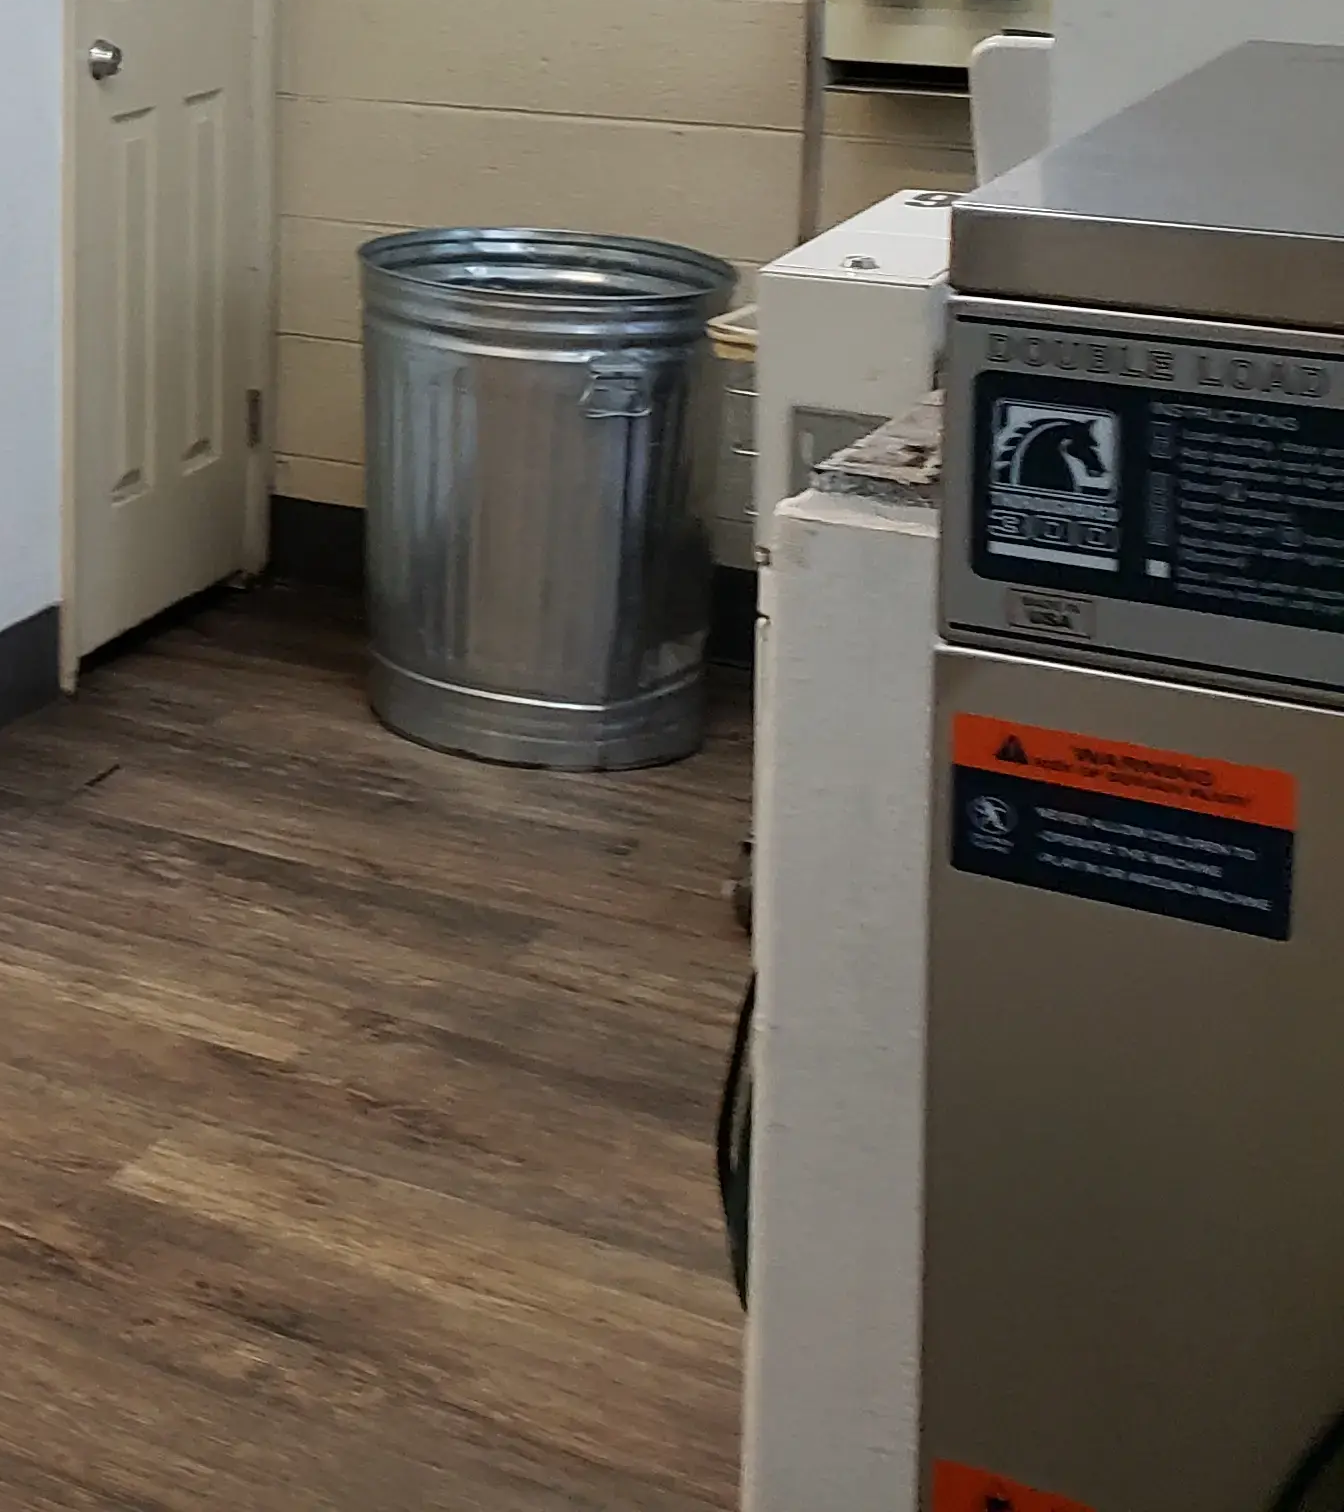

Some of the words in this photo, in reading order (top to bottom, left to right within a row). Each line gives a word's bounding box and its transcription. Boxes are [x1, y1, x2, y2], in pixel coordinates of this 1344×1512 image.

[986, 333, 1175, 382] DOUBLE
[1197, 354, 1330, 399] LOAD
[1028, 610, 1073, 629] USA
[1073, 745, 1213, 786] WARNING
